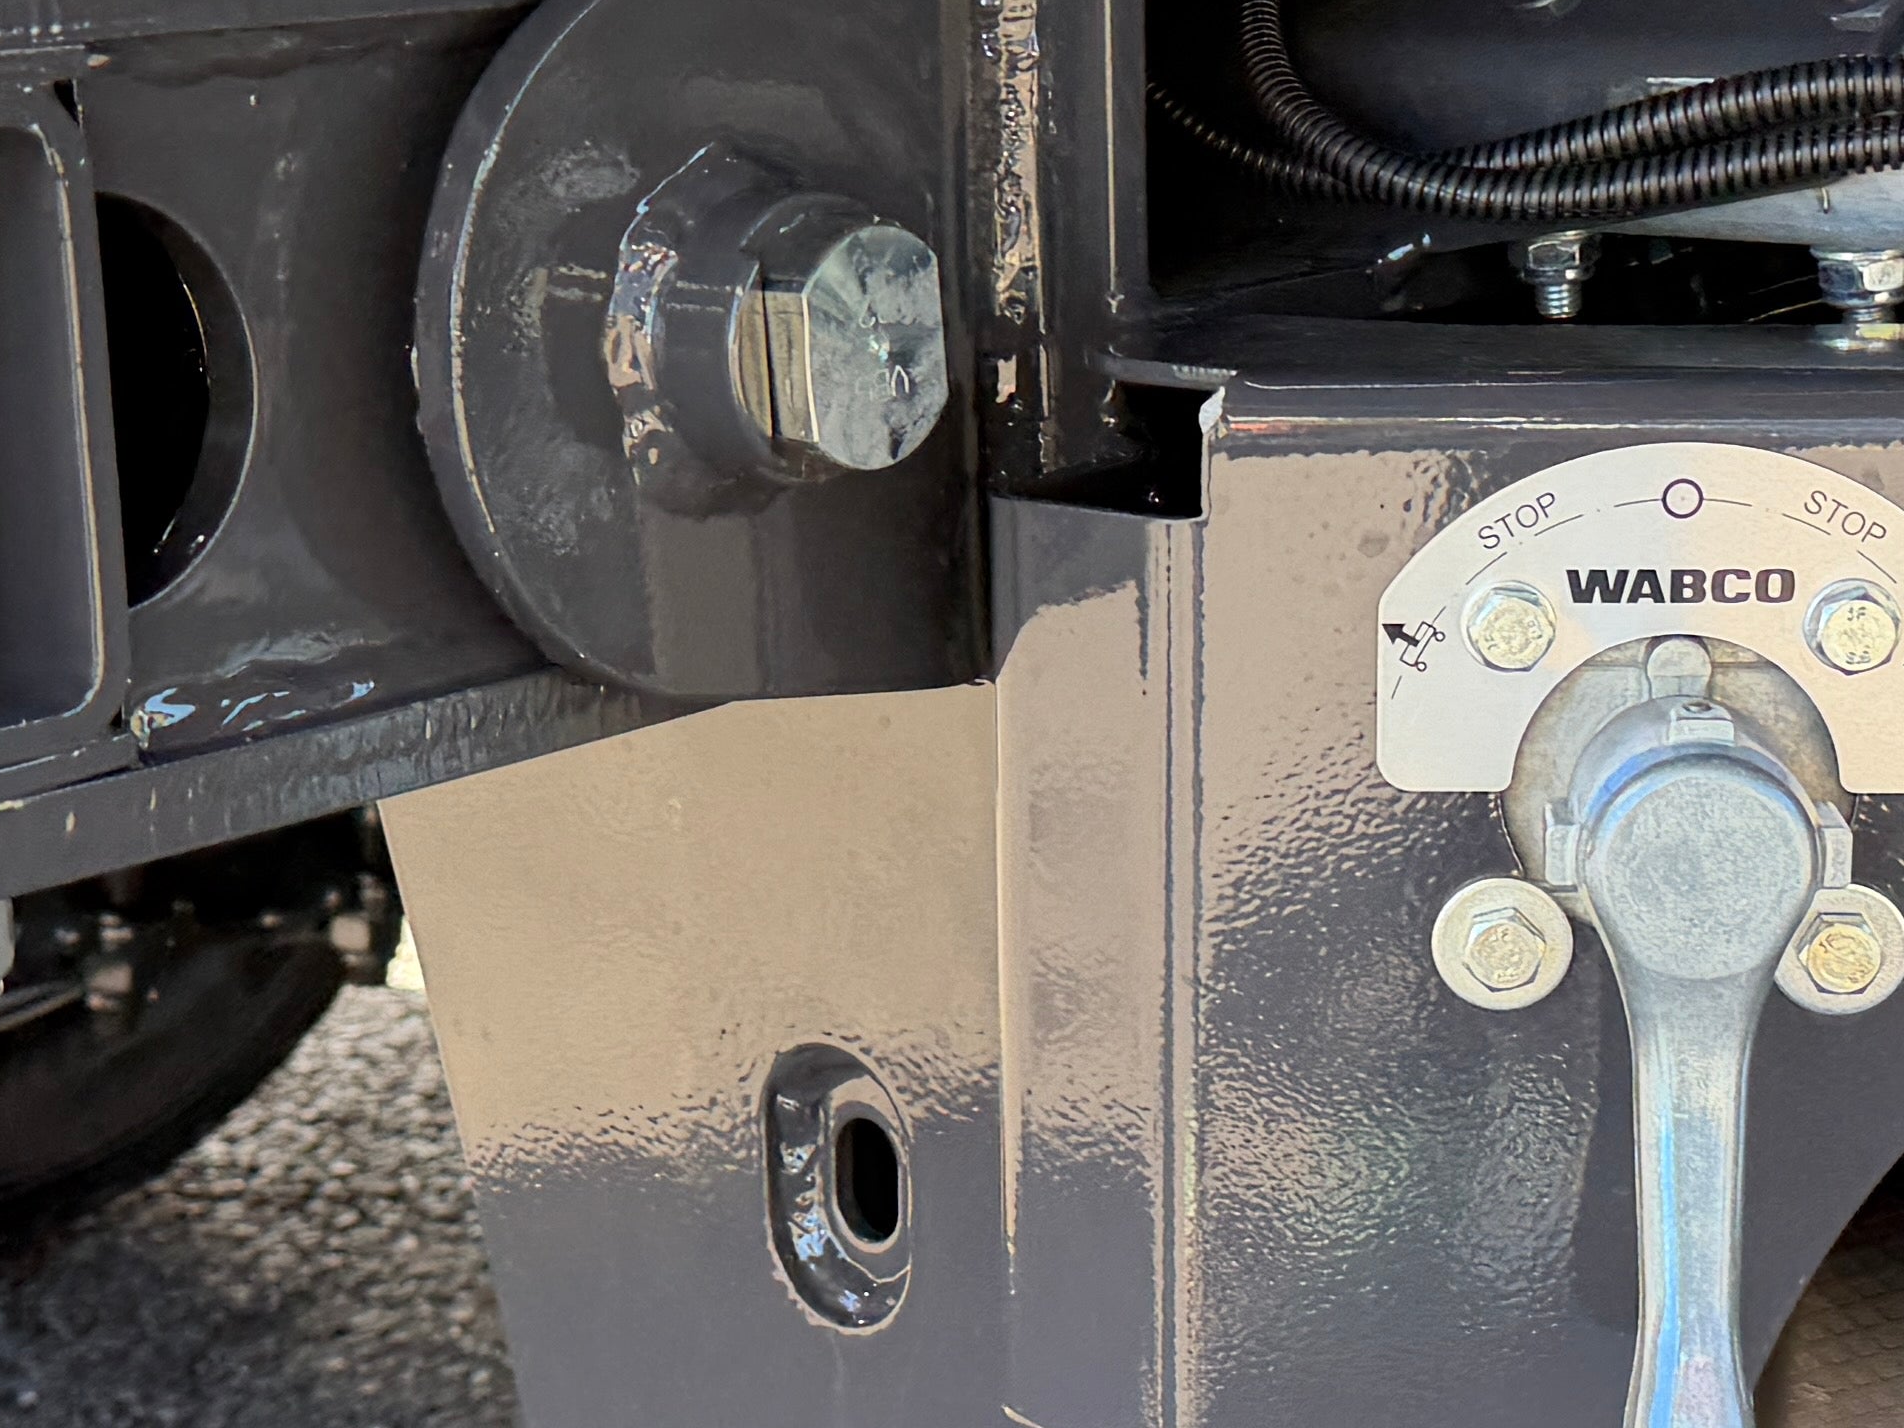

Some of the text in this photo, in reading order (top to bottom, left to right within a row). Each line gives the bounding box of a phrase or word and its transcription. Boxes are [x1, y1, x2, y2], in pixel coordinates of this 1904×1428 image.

[1477, 491, 1557, 550] STOP
[1803, 490, 1887, 546] STOP
[1565, 567, 1796, 604] WABCO
